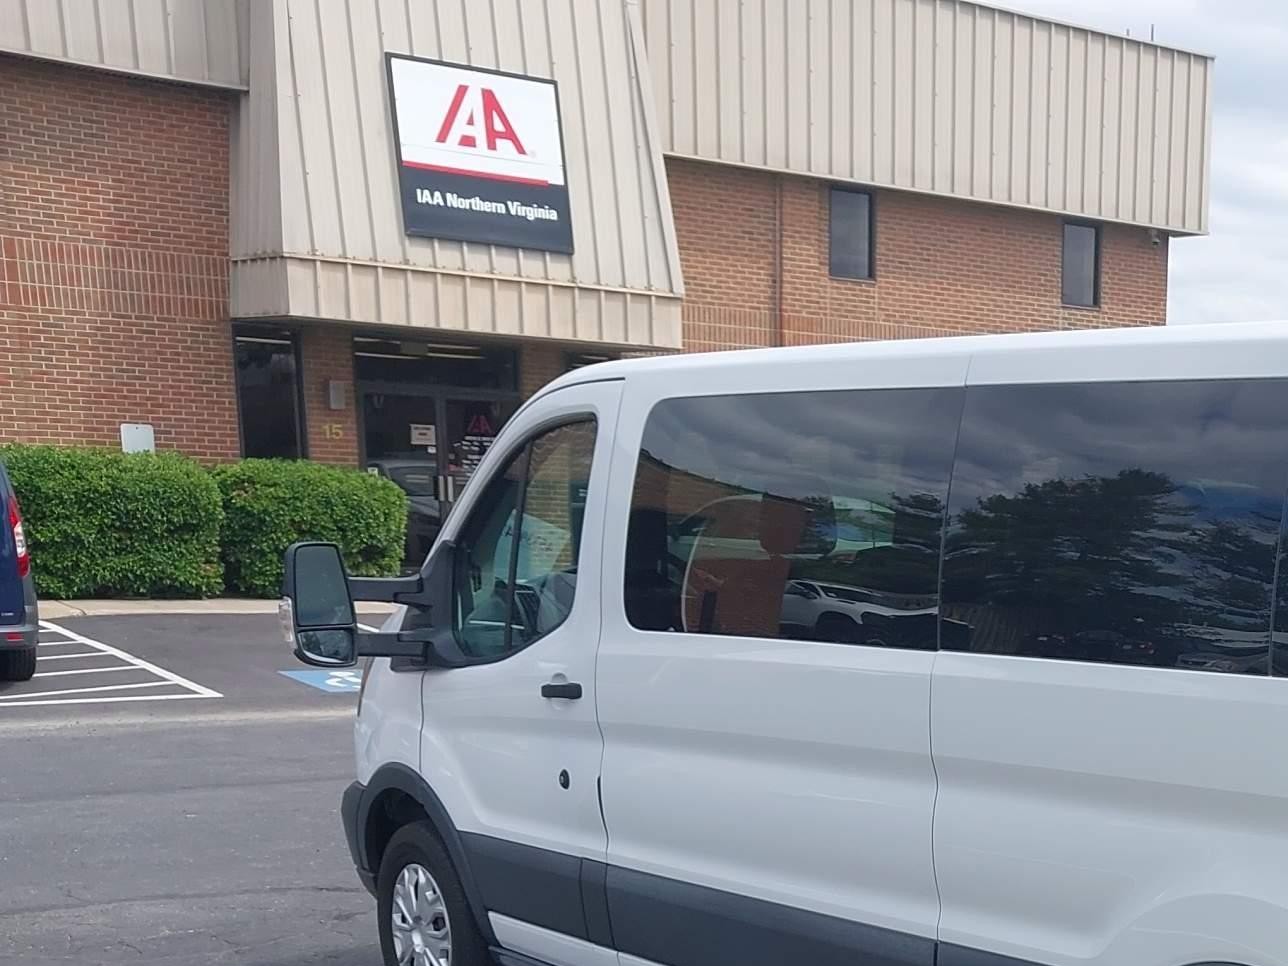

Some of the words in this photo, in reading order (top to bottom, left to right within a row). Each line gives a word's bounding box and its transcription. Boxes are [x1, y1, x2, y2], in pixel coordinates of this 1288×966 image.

[416, 188, 444, 206] IAA
[446, 192, 506, 214] Northern
[507, 201, 558, 221] Virginia
[322, 424, 343, 439] 15
